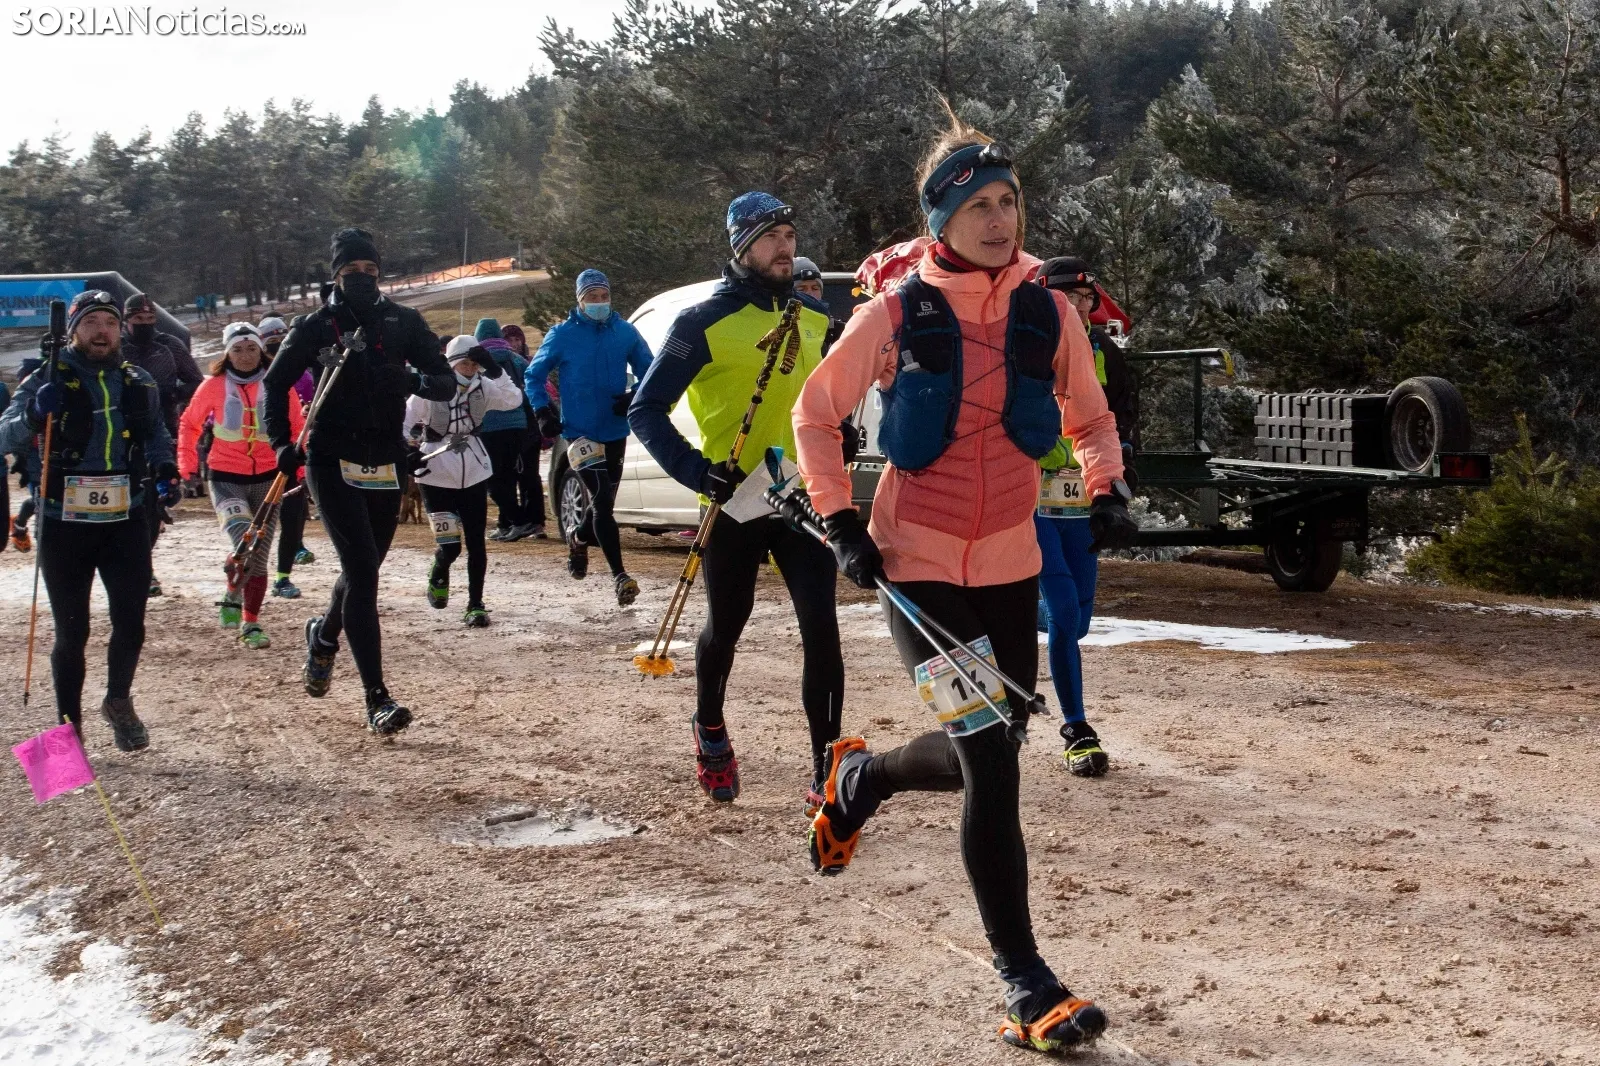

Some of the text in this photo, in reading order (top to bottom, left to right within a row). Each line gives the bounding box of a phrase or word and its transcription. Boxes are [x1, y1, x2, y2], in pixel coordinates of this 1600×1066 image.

[579, 444, 593, 456] 81
[1063, 482, 1079, 498] 84
[88, 491, 109, 505] 86
[226, 505, 242, 515] 18
[435, 521, 449, 532] 20
